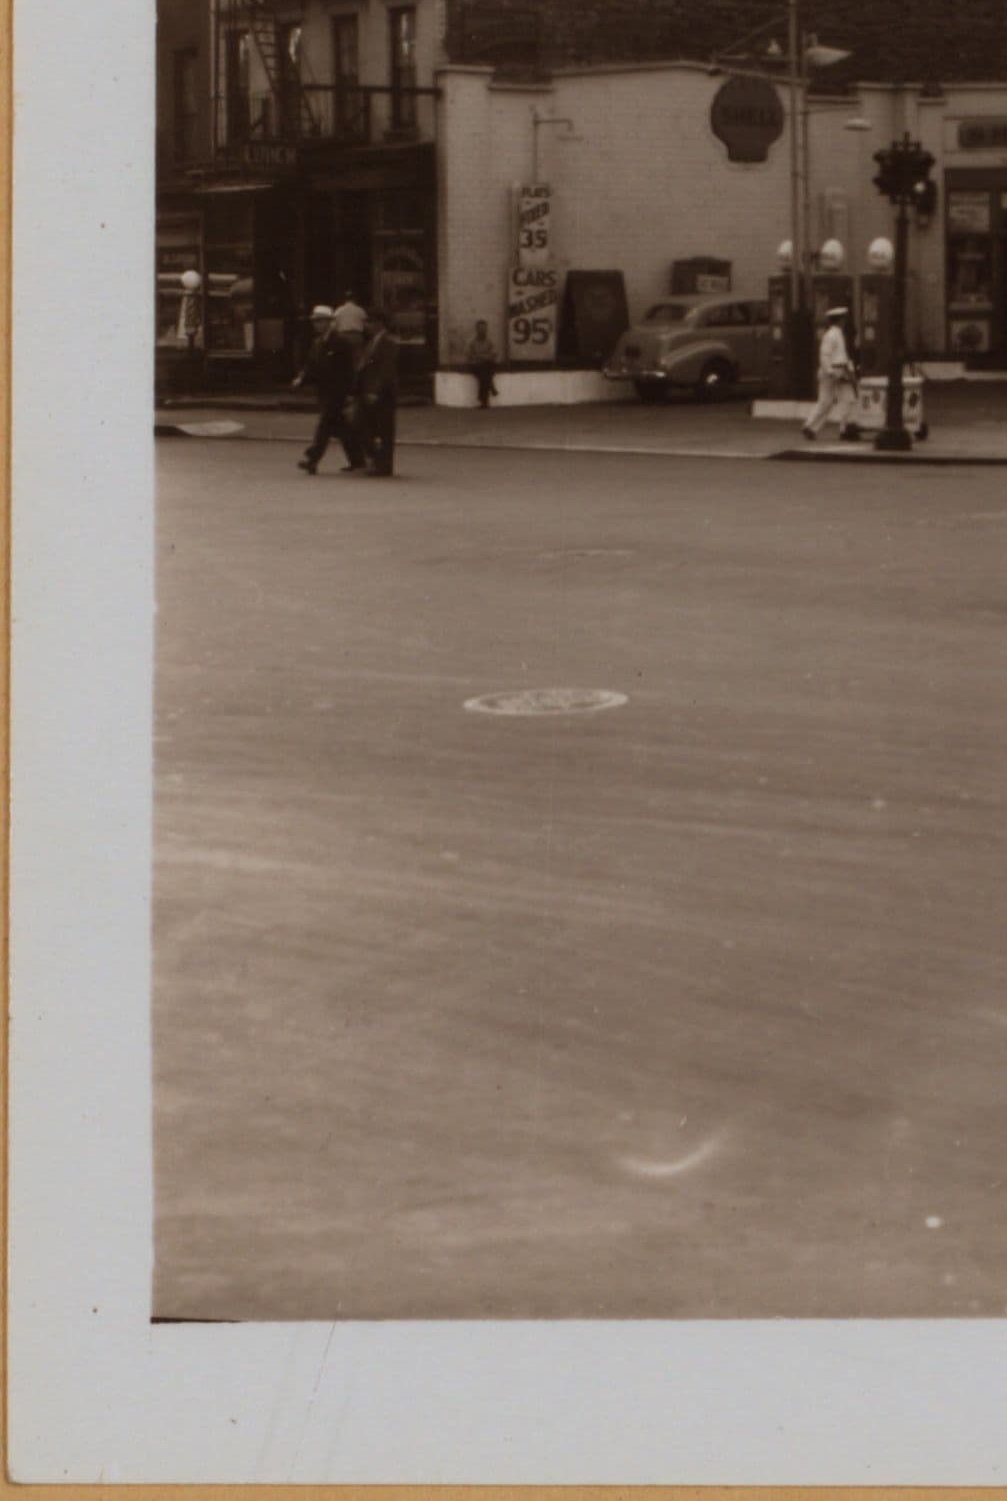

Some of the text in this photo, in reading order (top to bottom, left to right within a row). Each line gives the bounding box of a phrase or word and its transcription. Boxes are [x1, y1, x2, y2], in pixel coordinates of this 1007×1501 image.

[719, 105, 779, 127] SHELL
[520, 228, 549, 249] 35
[512, 267, 557, 288] CARS
[508, 289, 561, 319] WASHED
[512, 317, 550, 345] 95
